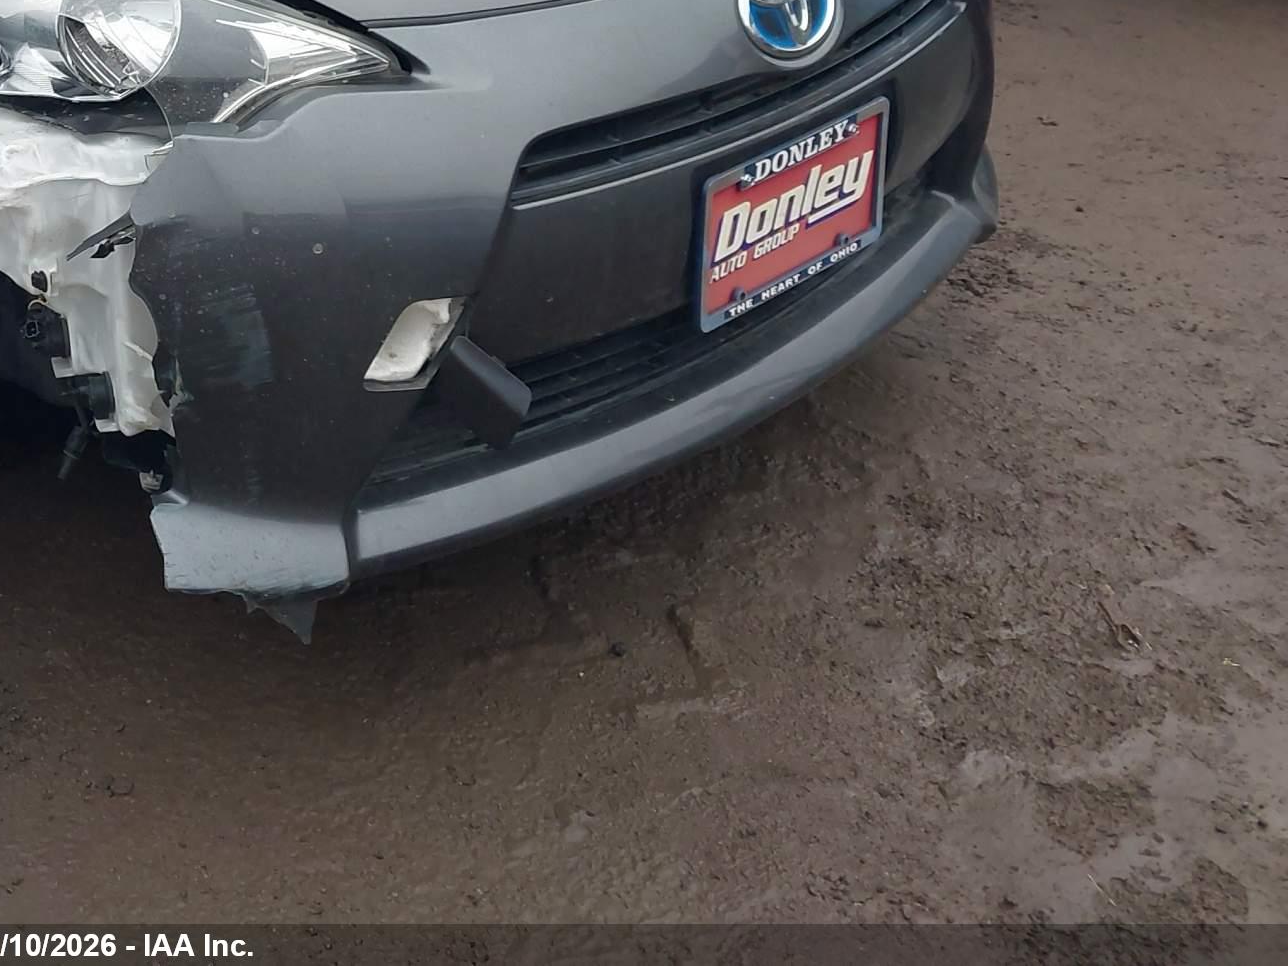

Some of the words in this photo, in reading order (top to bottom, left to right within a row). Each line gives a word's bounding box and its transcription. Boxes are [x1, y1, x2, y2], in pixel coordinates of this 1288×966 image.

[754, 119, 849, 182] DONLEY
[714, 149, 874, 264] Donley
[709, 251, 748, 284] AUTO
[752, 223, 800, 260] GROUP
[728, 298, 754, 318] THE
[761, 273, 800, 301] HEART
[807, 261, 824, 276] OF
[829, 241, 859, 264] OHIO
